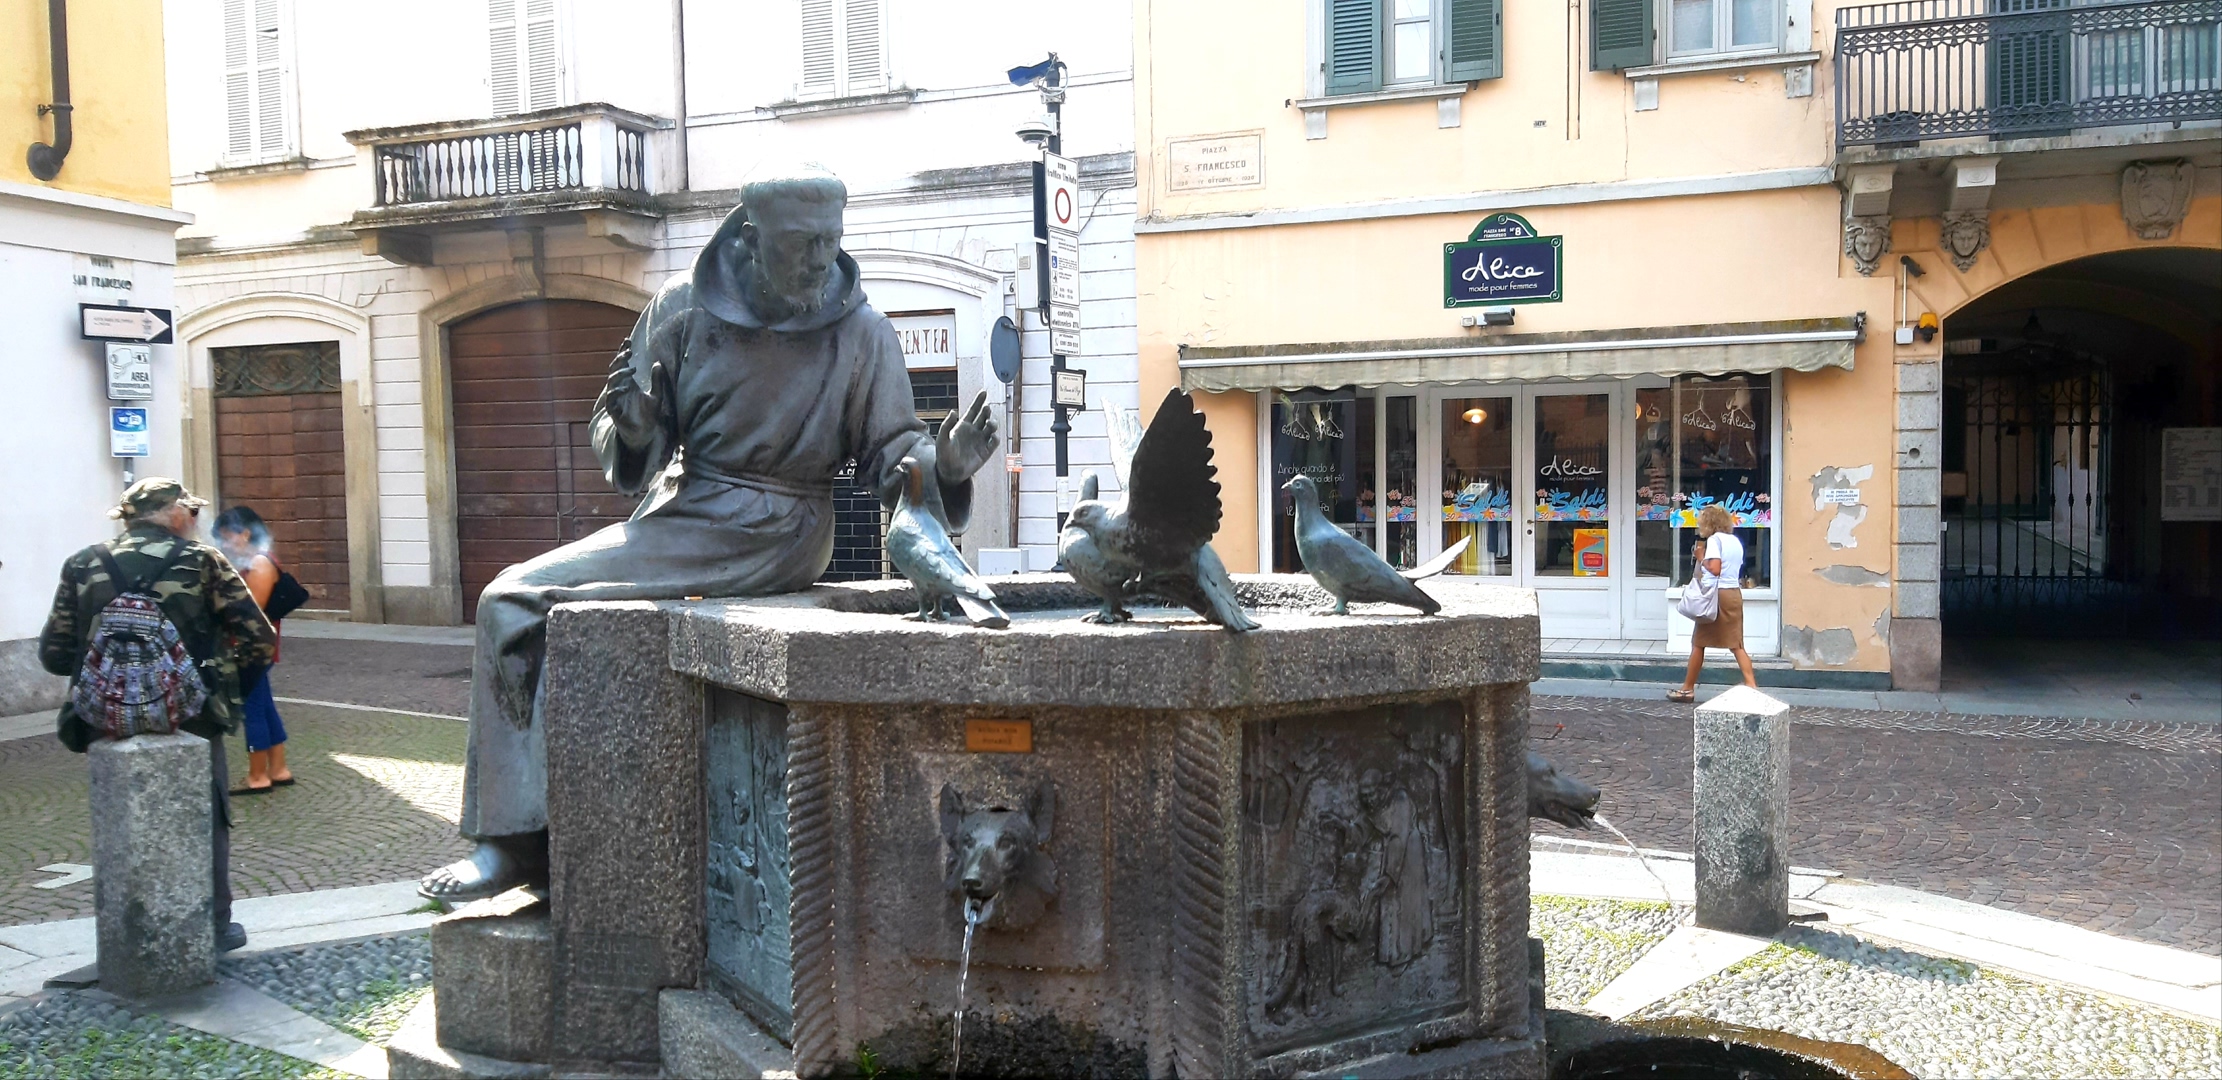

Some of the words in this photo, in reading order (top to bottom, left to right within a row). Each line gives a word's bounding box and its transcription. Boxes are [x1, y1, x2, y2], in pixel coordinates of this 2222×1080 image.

[1201, 145, 1227, 155] PIAZZA
[1196, 160, 1247, 172] FRANCESCO
[1514, 227, 1522, 236] 8
[1461, 252, 1545, 282] Alice
[91, 276, 133, 291] FRANCESCO
[1009, 283, 1015, 293] 6
[1468, 283, 1489, 293] mode
[1489, 284, 1508, 295] pour
[1509, 281, 1538, 291] femmes
[131, 371, 149, 382] AREA
[1277, 462, 1300, 474] Anche
[1300, 462, 1327, 476] quando
[1540, 454, 1604, 476] Alice
[1456, 489, 1510, 511] Saldi
[1552, 487, 1606, 511] Saldi
